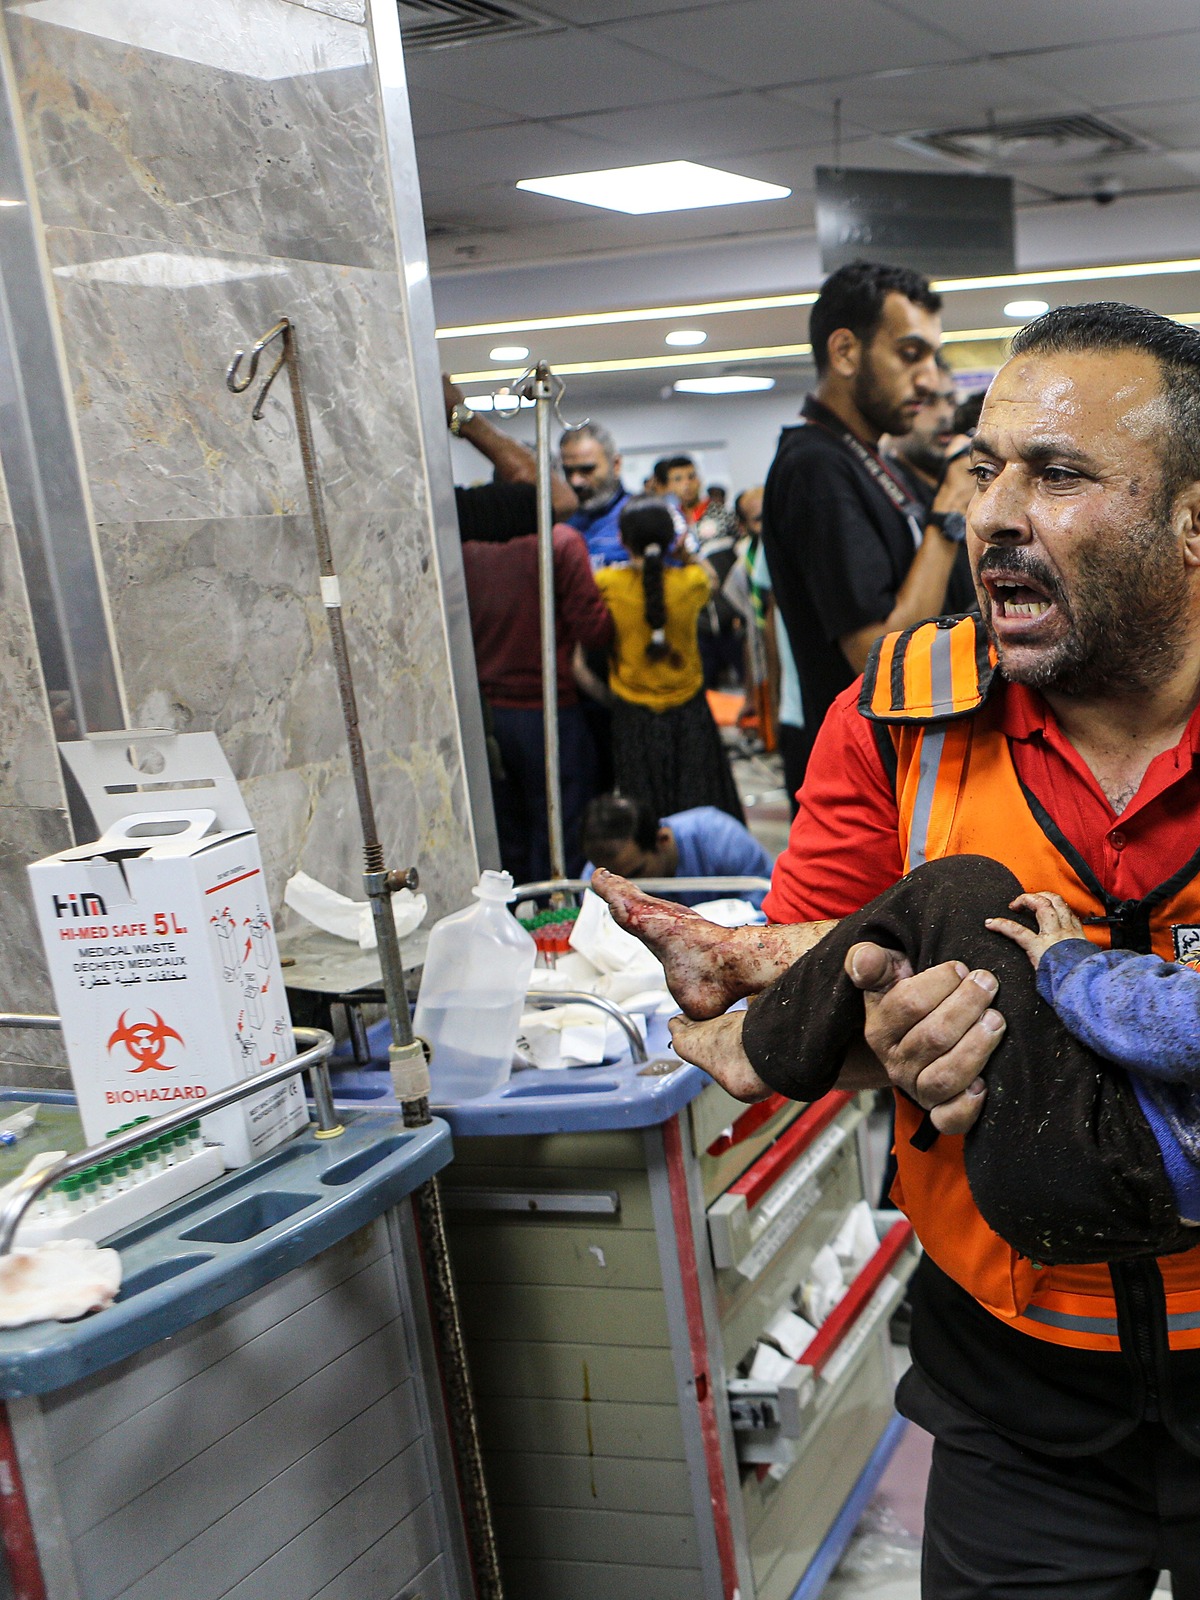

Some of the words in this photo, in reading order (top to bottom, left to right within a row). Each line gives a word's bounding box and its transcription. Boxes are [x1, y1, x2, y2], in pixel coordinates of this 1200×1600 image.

[60, 926, 109, 940] HI-MED
[112, 923, 148, 937] SAFE
[78, 946, 132, 958] MEDICAL
[133, 942, 176, 954] WASTE
[128, 956, 187, 969] MEDICAUX
[79, 974, 111, 989] خطرة
[115, 971, 141, 988] طبية
[146, 970, 187, 982] مخلفات
[105, 1086, 207, 1104] BIOHAZARD
